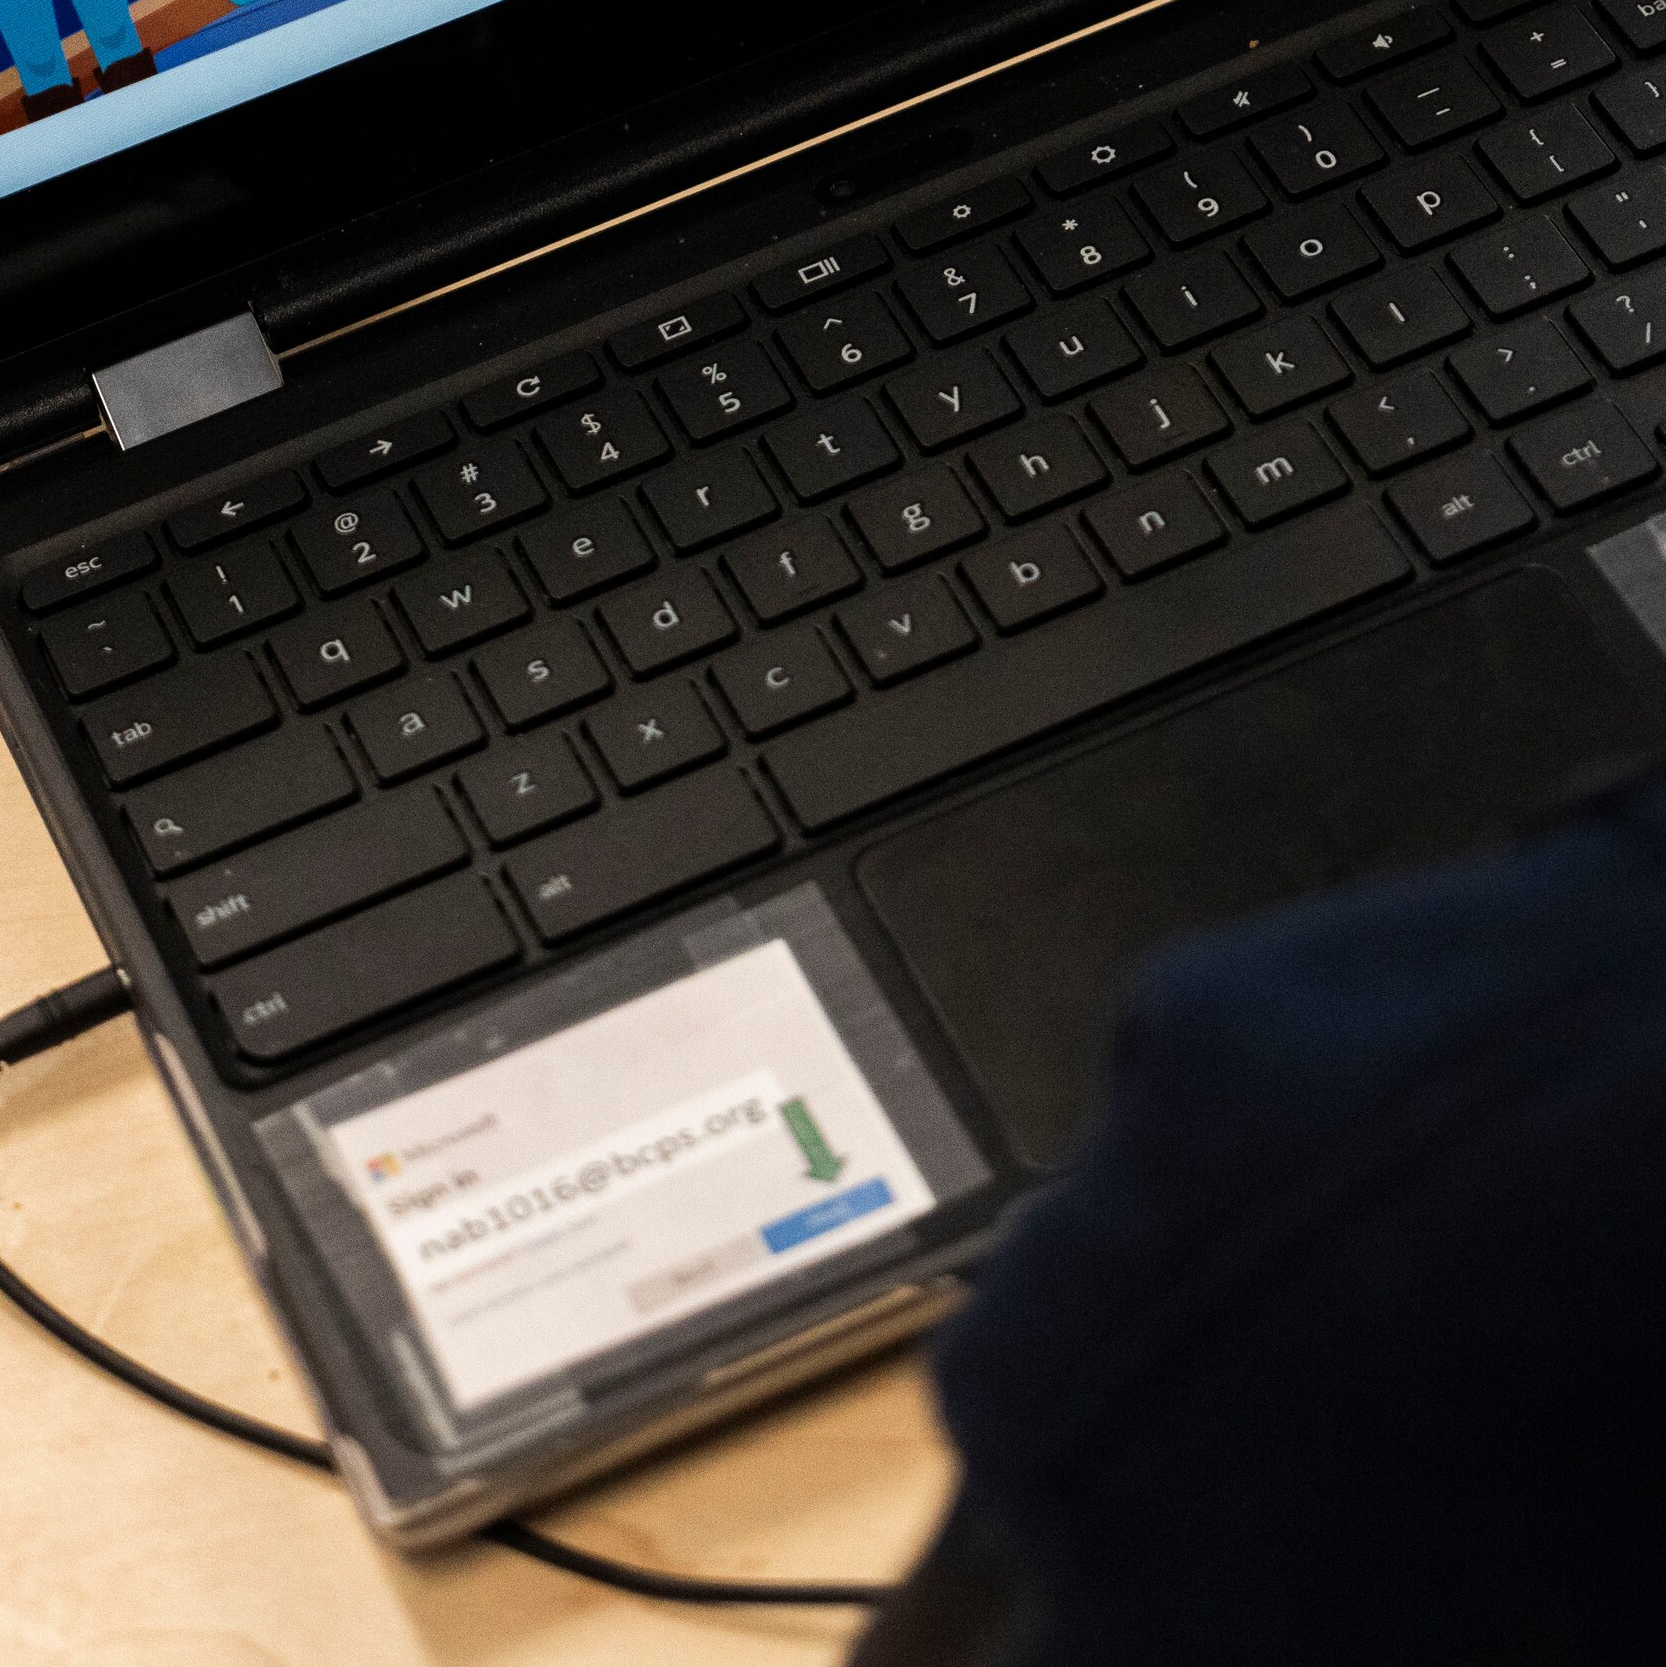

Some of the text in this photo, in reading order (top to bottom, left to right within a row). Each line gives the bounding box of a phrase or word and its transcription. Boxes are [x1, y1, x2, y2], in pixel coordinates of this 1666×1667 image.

[1315, 150, 1337, 169] 0
[1198, 198, 1219, 217] 9
[1417, 189, 1442, 215] p
[1080, 245, 1102, 265] 8
[1300, 239, 1323, 257] o
[943, 267, 965, 286] &
[958, 293, 978, 315] 7
[1181, 286, 1198, 307] i
[1616, 295, 1635, 314] ?
[841, 343, 862, 363] 6
[1060, 336, 1084, 356] u
[1266, 351, 1295, 373] k
[702, 364, 727, 384] %
[718, 392, 741, 413] 5
[939, 387, 961, 412] y
[581, 413, 602, 435] $
[1150, 398, 1172, 429] j
[599, 442, 620, 462] 4
[817, 432, 841, 454] t
[1562, 440, 1601, 466] ctrl
[460, 463, 480, 484] #
[1020, 451, 1049, 476] h
[1255, 455, 1294, 483] m
[474, 492, 497, 513] 3
[695, 485, 713, 506] r
[1442, 494, 1474, 517] alt
[334, 513, 359, 534] @
[903, 503, 931, 532] g
[1138, 510, 1166, 533] n
[352, 542, 377, 564] 2
[573, 536, 595, 557] e
[64, 554, 102, 579] esc
[780, 552, 797, 576] f
[1010, 560, 1040, 584] b
[228, 595, 244, 613] 1
[440, 585, 474, 609] w
[653, 602, 679, 629] d
[889, 614, 912, 634] v
[320, 638, 349, 664] q
[527, 659, 550, 682] s
[766, 667, 789, 688] c
[112, 719, 153, 747] tab
[400, 712, 424, 735] a
[639, 719, 664, 742] x
[512, 773, 535, 795] z
[538, 874, 571, 899] alt
[195, 893, 250, 928] shift
[242, 993, 287, 1026] ctrl
[418, 1094, 767, 1263] nab1016@bcps.org
